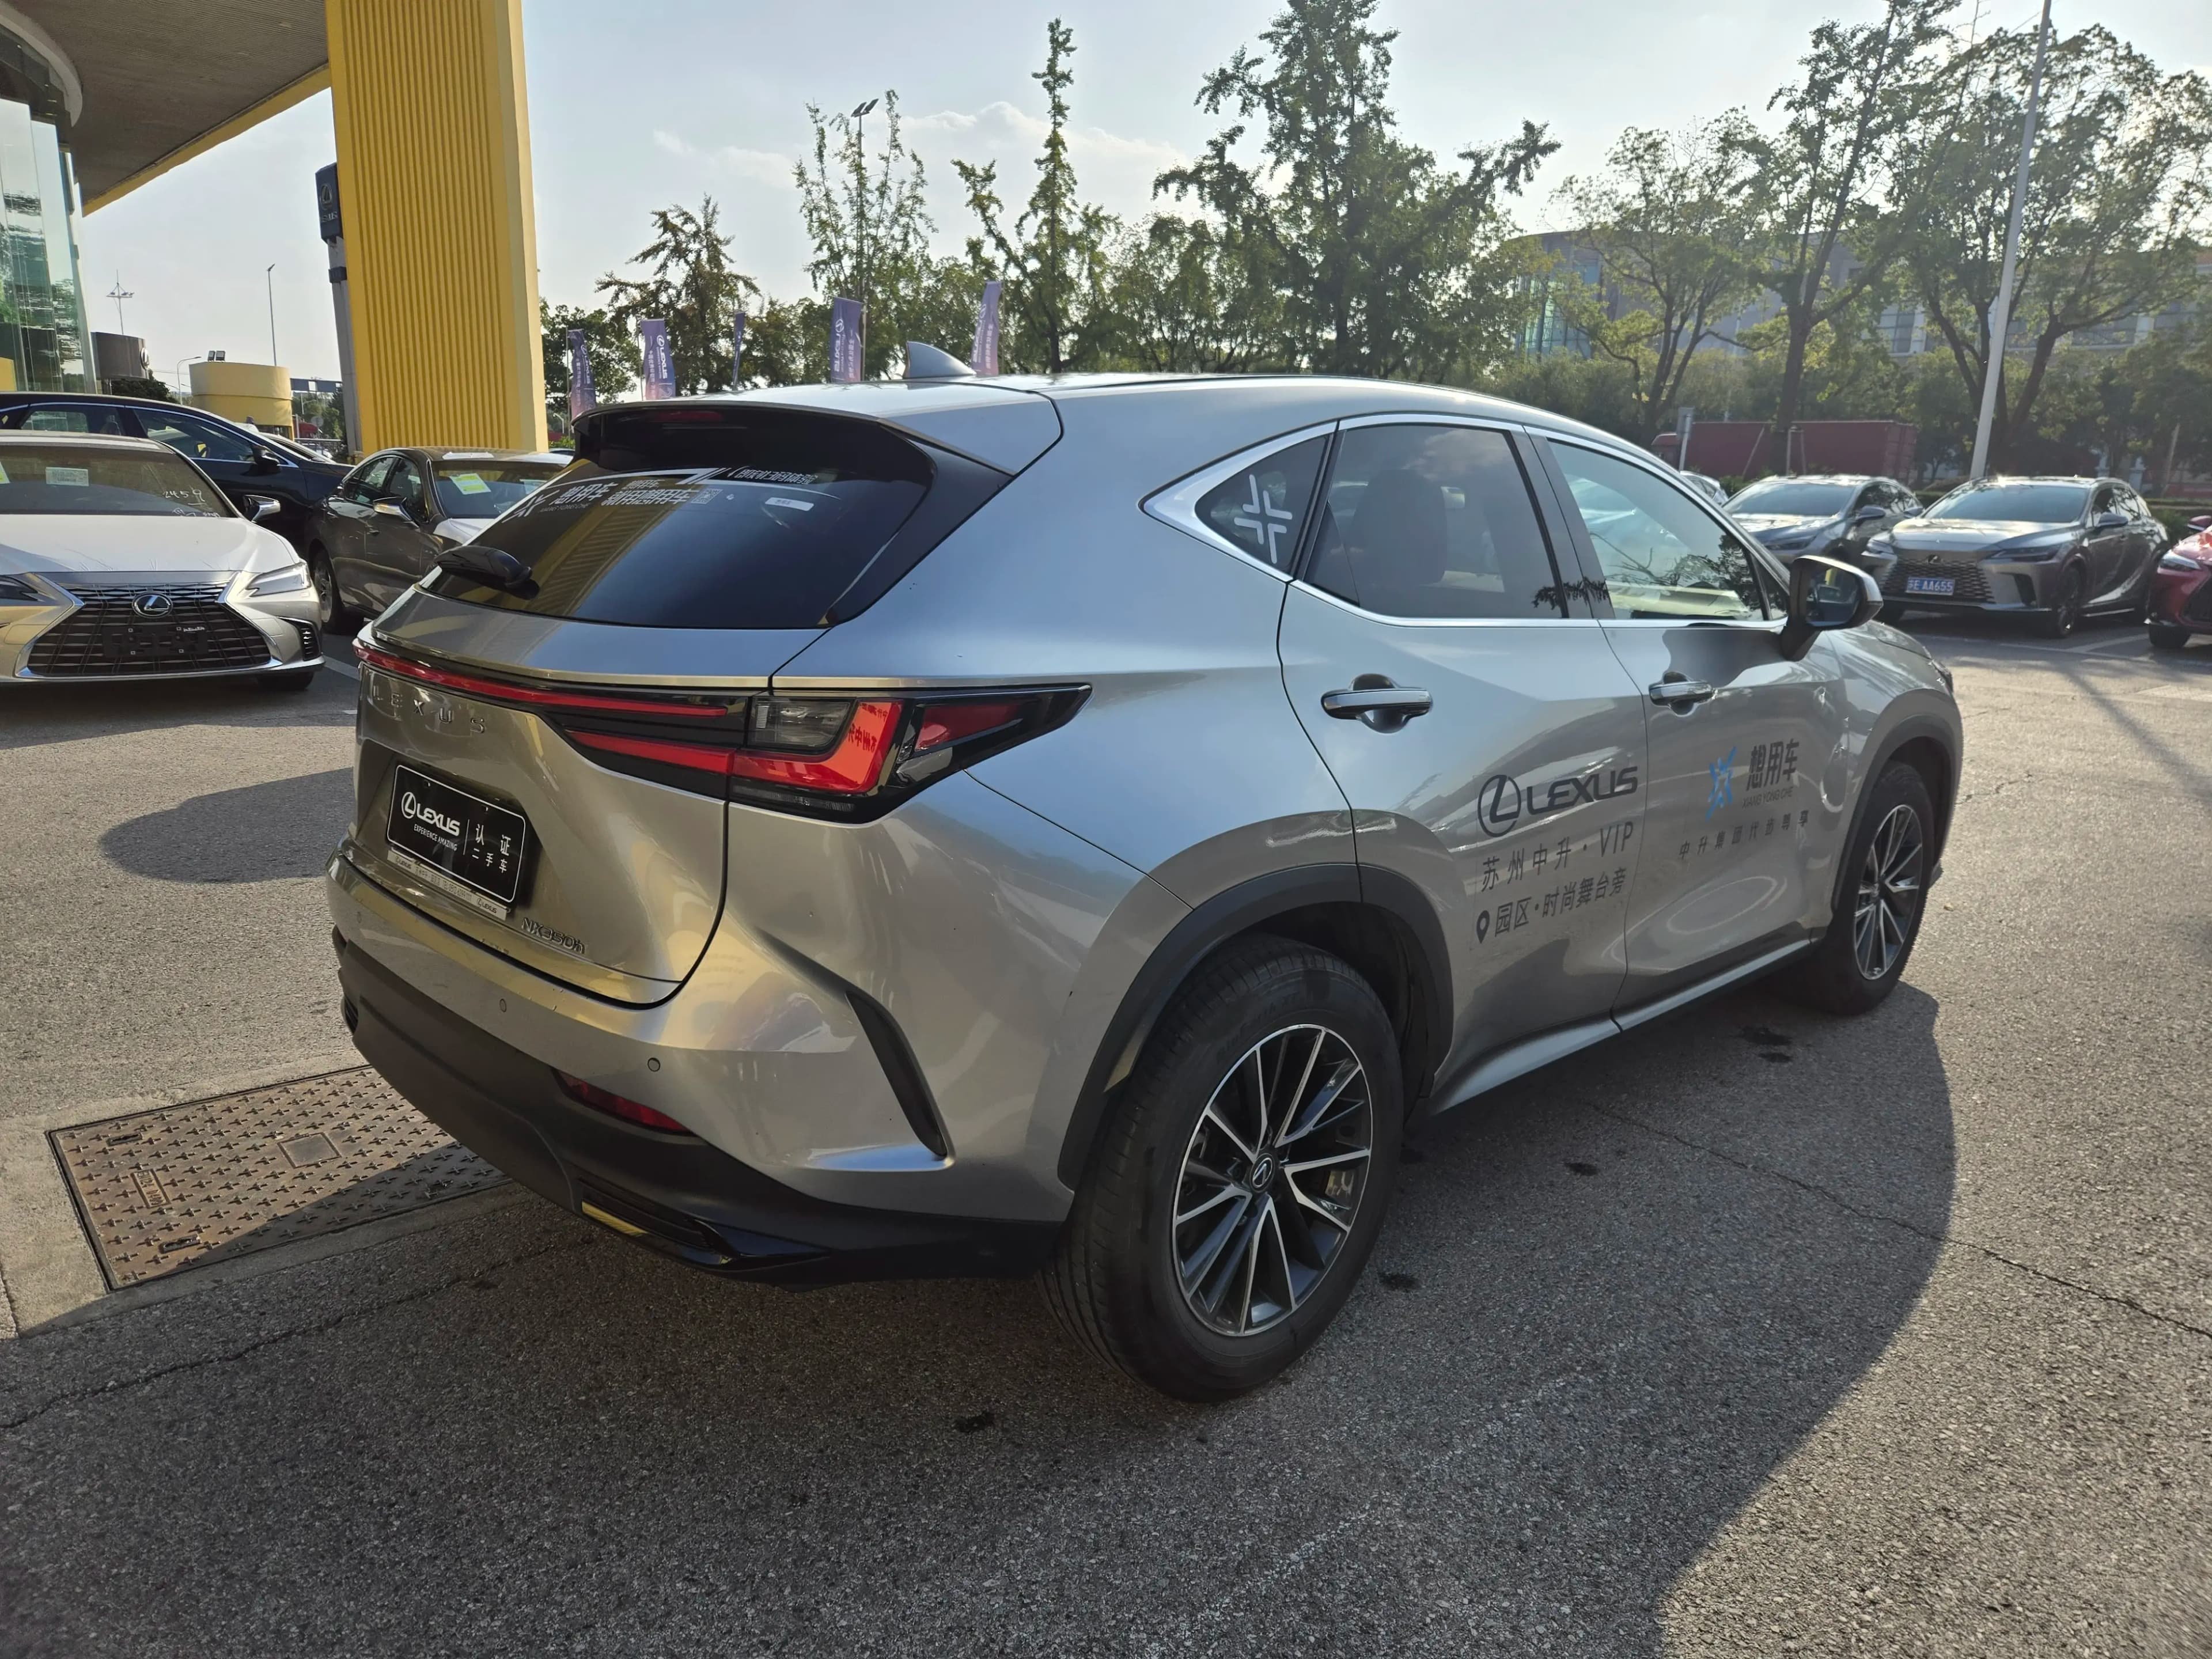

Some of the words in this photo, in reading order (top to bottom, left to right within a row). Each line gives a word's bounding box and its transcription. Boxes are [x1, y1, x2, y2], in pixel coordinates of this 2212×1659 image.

[660, 347, 668, 379] LEXUS
[162, 489, 206, 502] 2459
[548, 482, 619, 506] 想用车
[1746, 738, 1800, 791] 想用车
[1527, 766, 1638, 815] LEXUS
[416, 803, 461, 836] LEXUS
[414, 823, 438, 842] EXPERIENCE
[438, 836, 458, 851] AMAZING
[475, 823, 512, 856] 认证
[472, 847, 507, 874] 二手车
[521, 917, 585, 955] NX350h
